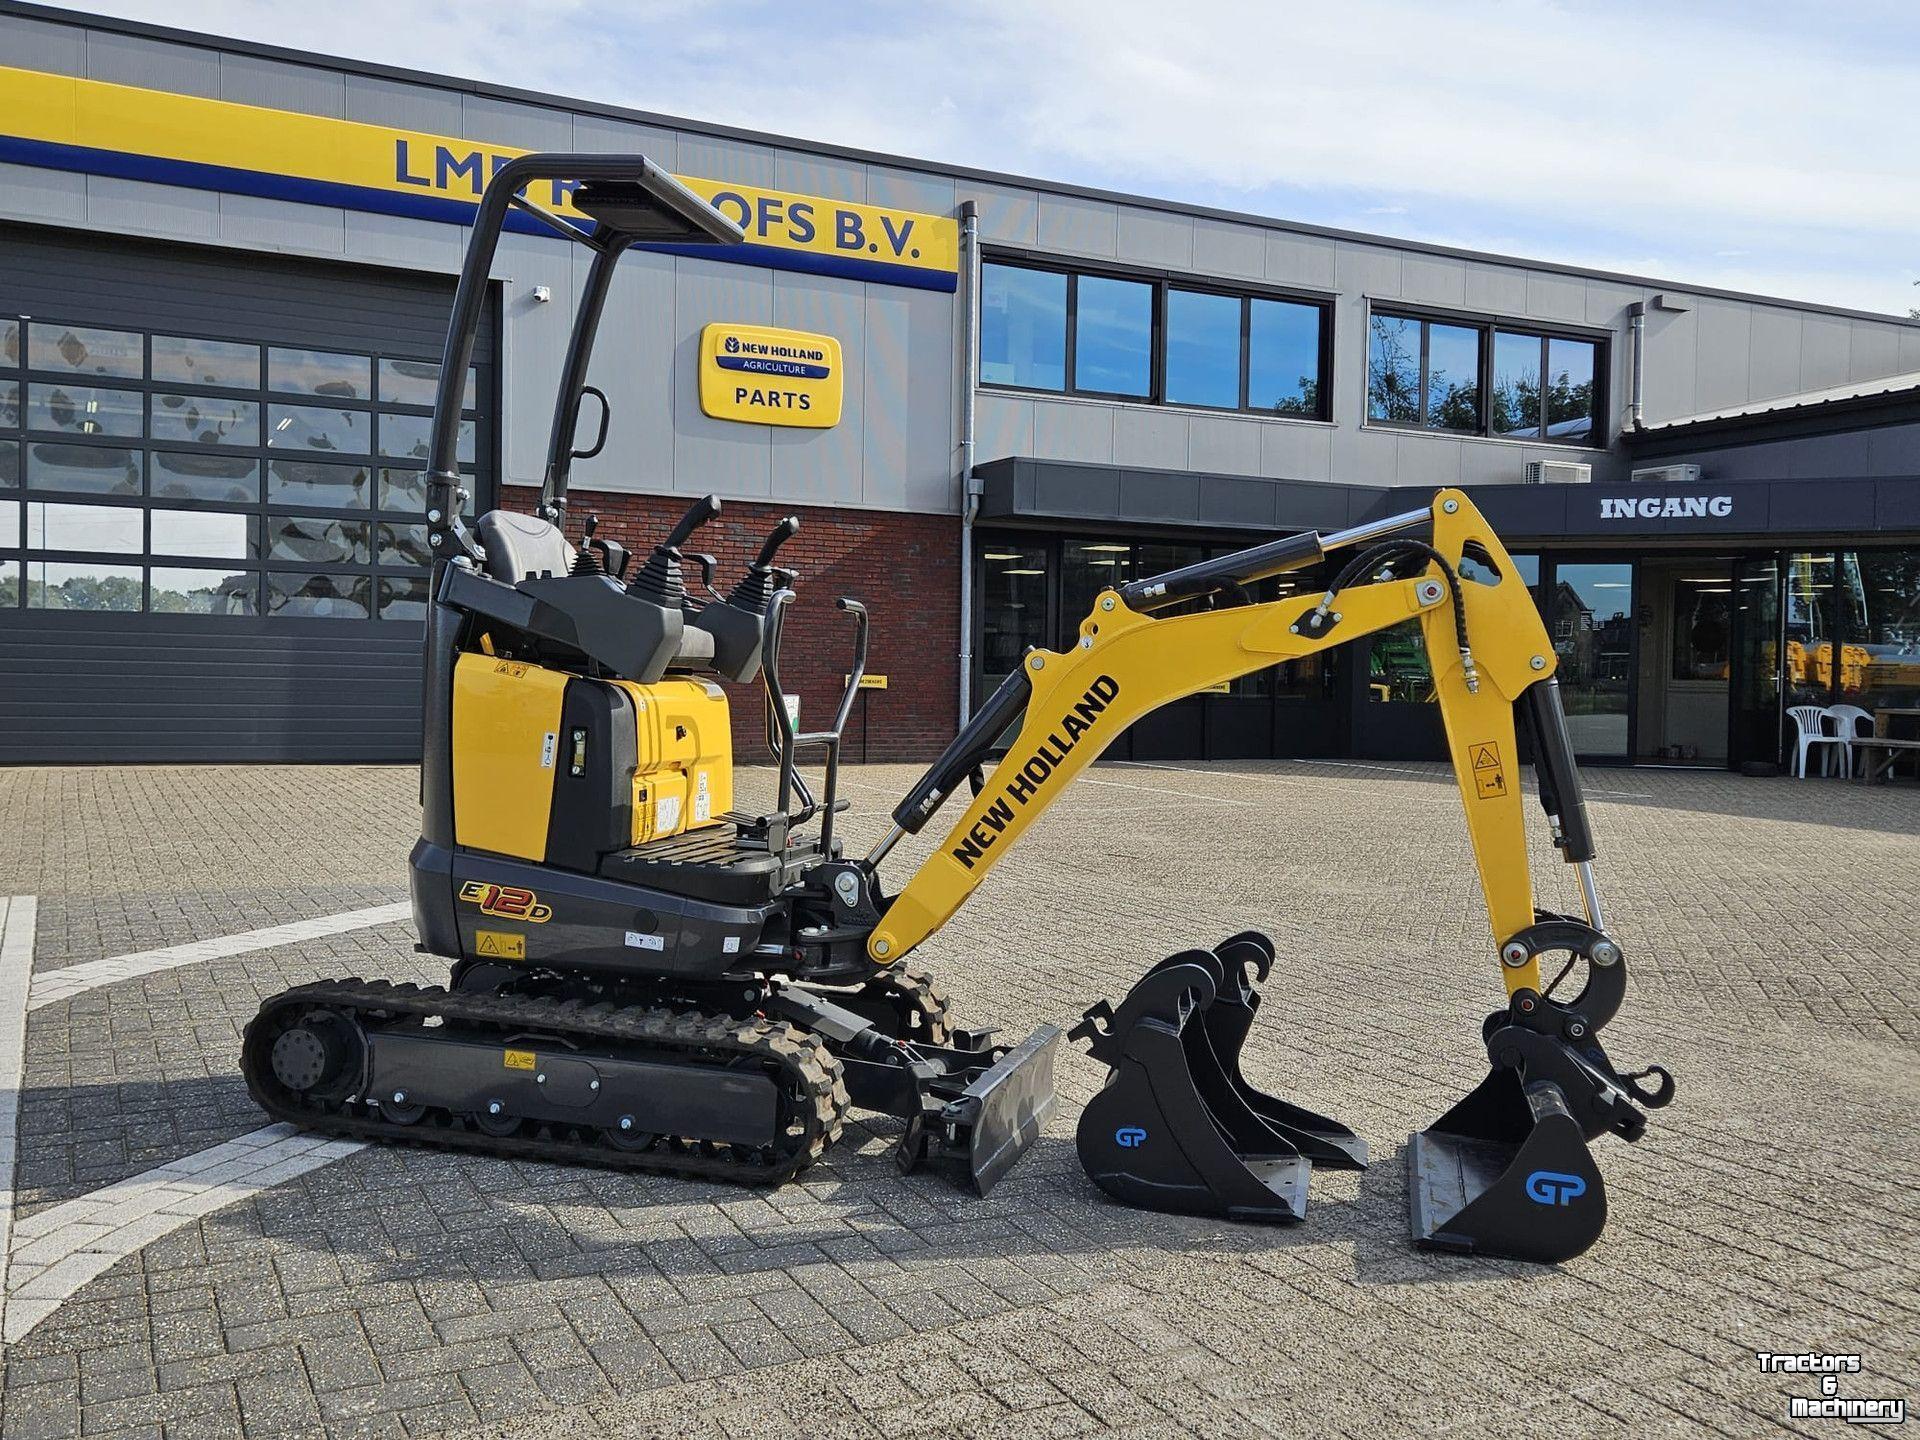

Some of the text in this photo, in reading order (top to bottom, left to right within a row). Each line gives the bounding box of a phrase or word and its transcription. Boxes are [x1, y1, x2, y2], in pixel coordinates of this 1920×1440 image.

[835, 209, 920, 259] B.V.
[742, 343, 823, 361] NEW HOLLAND
[743, 360, 806, 375] AGRICULTURE
[735, 387, 811, 410] PARTS
[1600, 496, 1732, 519] INGANG
[952, 674, 1120, 870] NEW HOLLAND
[460, 881, 552, 922] E12D
[1115, 1128, 1147, 1147] GP
[1525, 1171, 1587, 1206] GP
